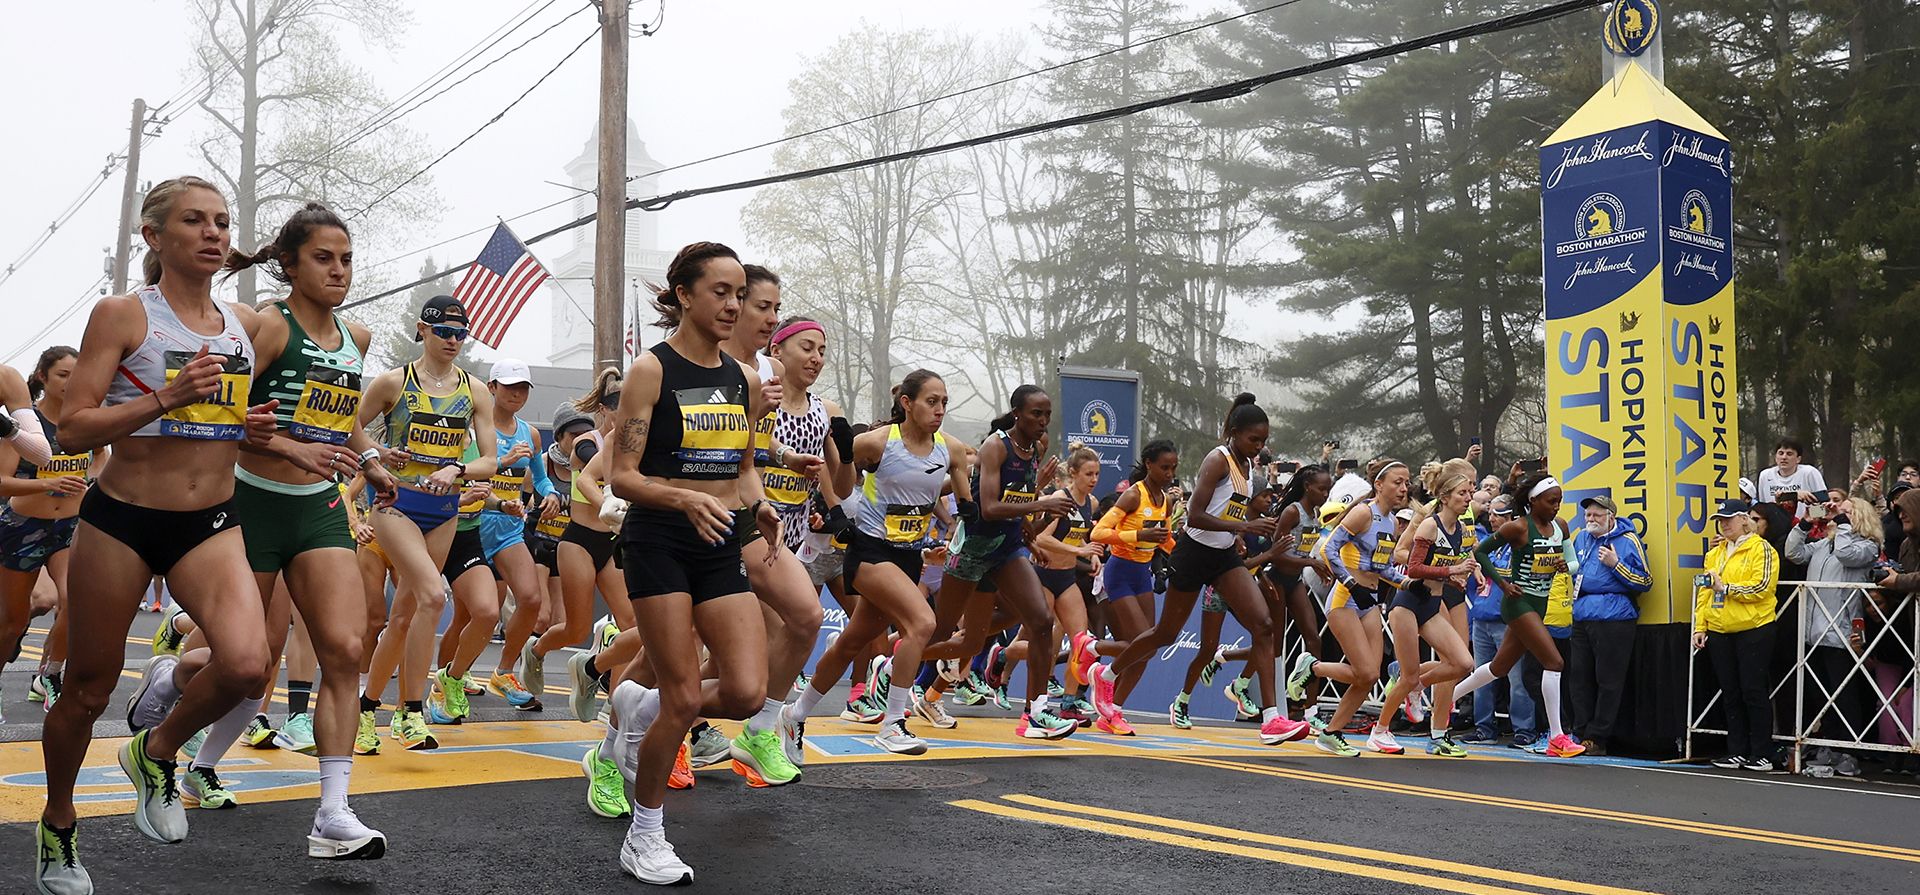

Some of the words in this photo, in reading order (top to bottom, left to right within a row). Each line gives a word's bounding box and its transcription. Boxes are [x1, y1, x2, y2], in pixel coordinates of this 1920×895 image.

[1547, 145, 1588, 189] John
[1588, 130, 1653, 162] Hancock
[1662, 130, 1690, 167] John
[1689, 135, 1728, 178] Hancock
[1556, 240, 1592, 255] BOSTON
[1594, 230, 1645, 248] MARATHON
[1669, 229, 1692, 242] BOSTON
[1692, 235, 1725, 250] MARATHON
[1563, 261, 1592, 290] John
[1592, 253, 1637, 274] Hancock
[1673, 251, 1692, 276] John
[1692, 253, 1719, 281] Hancock
[306, 387, 359, 417] ROJAS
[686, 412, 748, 432] MONTOYA
[410, 427, 464, 447] COOGAN
[1067, 435, 1094, 443] BOSTON
[1094, 436, 1129, 445] MARATHON
[40, 457, 89, 472] MORENO
